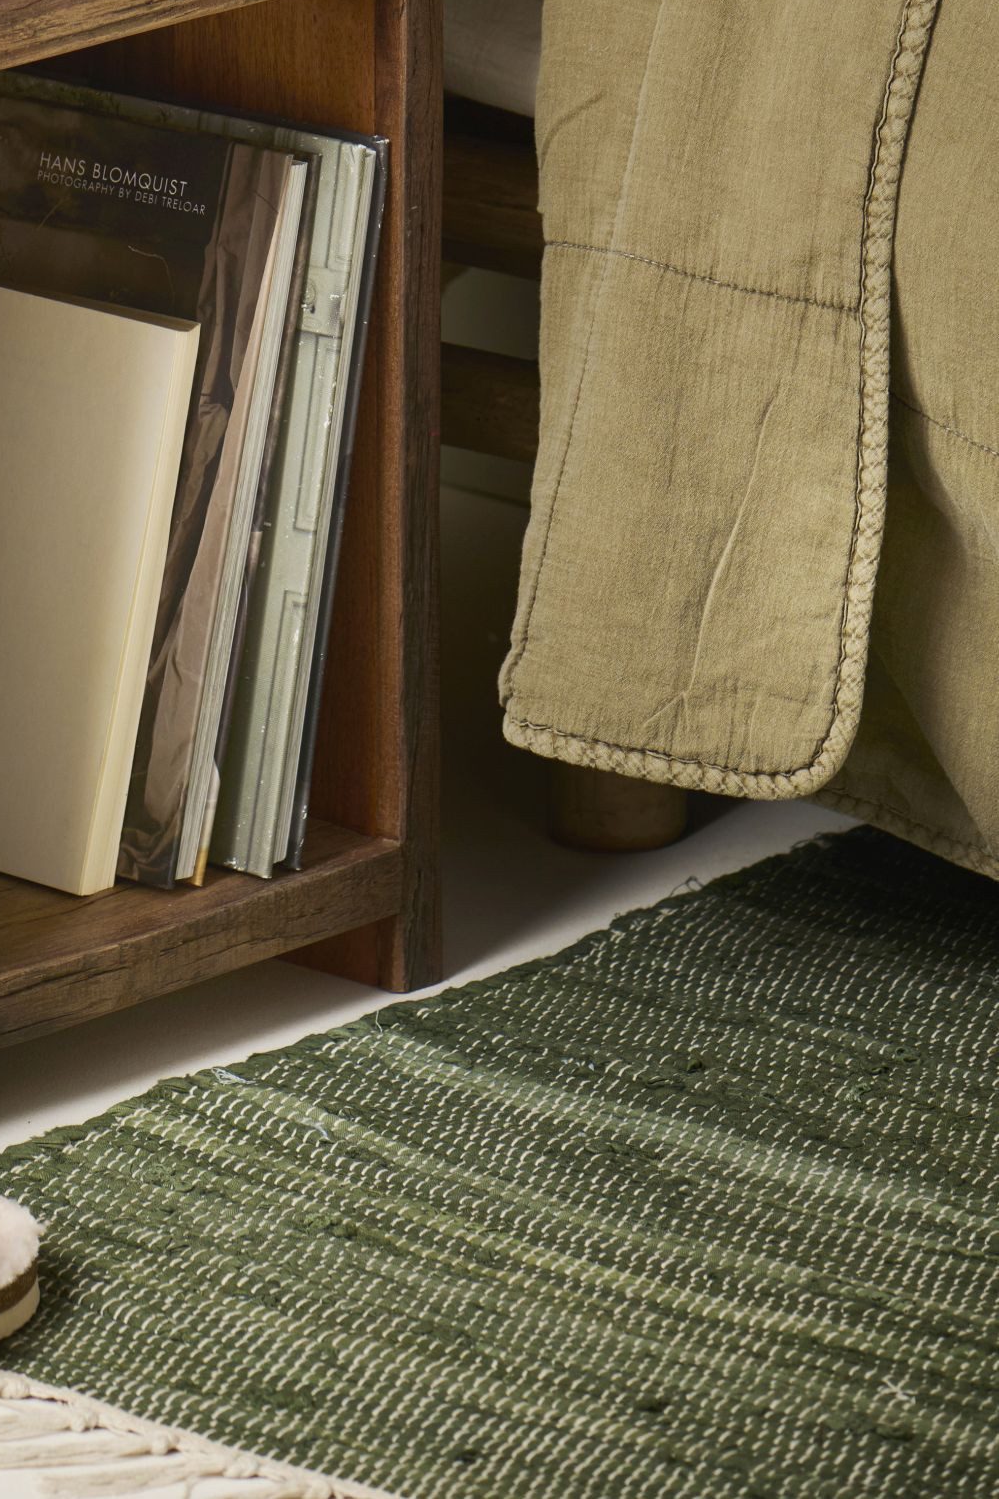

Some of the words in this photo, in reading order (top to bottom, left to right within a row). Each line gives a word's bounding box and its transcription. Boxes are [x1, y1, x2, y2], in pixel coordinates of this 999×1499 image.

[37, 170, 115, 196] PHOTOGRAPHY
[118, 187, 132, 199] BY
[134, 190, 158, 205] DEBI
[161, 196, 206, 216] TRELOAR
[39, 152, 86, 176] HANS
[92, 163, 188, 197] BLOMQUIST
